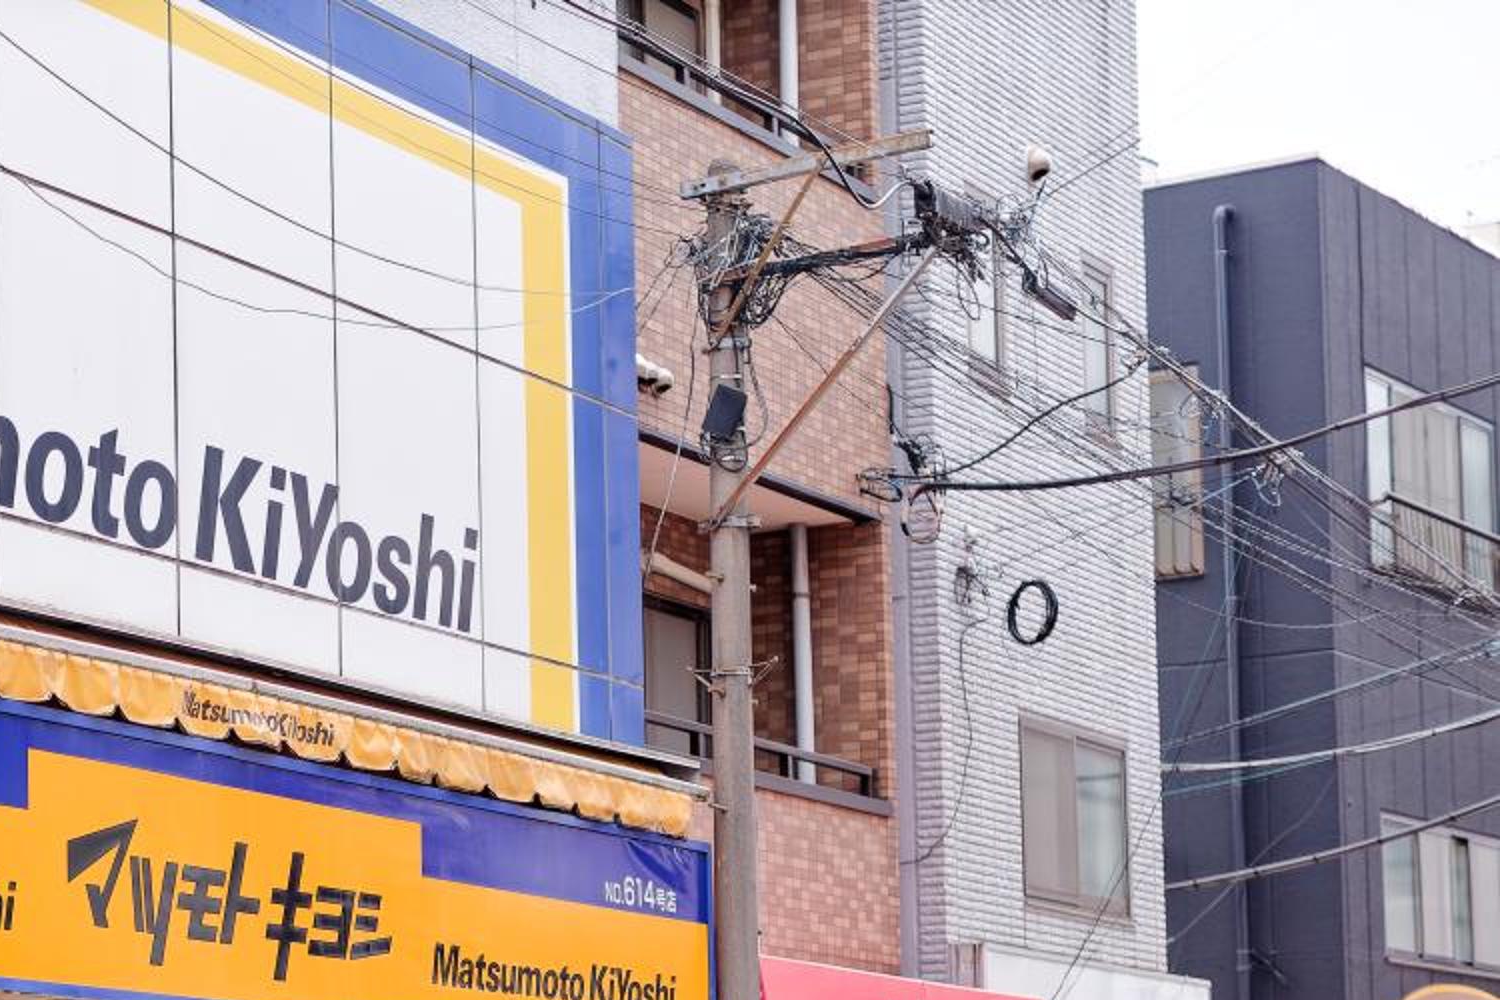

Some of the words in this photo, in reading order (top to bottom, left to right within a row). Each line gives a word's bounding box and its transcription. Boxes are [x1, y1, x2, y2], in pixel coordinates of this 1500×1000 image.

[194, 445, 479, 633] KiYoshi
[65, 818, 393, 981] マツモトキヨシ
